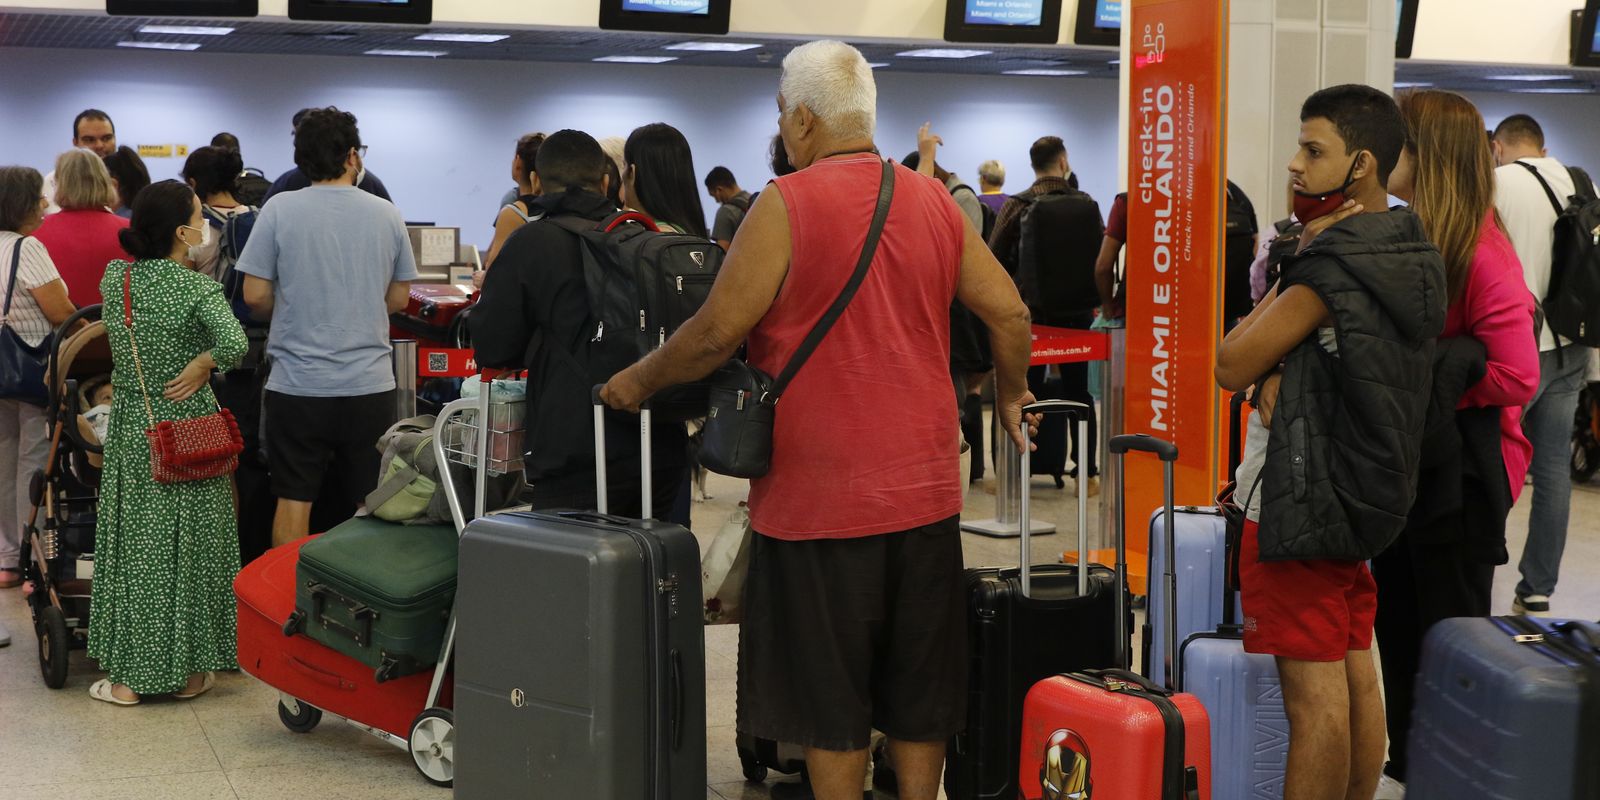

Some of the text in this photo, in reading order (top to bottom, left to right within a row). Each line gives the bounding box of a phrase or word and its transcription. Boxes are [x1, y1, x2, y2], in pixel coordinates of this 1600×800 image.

[1187, 83, 1195, 133] Orlando
[1139, 87, 1153, 204] check-in
[1187, 134, 1195, 160] and
[1185, 162, 1195, 200] Miami
[1150, 85, 1174, 431] MIAMI E ORLANDO
[1184, 210, 1193, 262] Check-in
